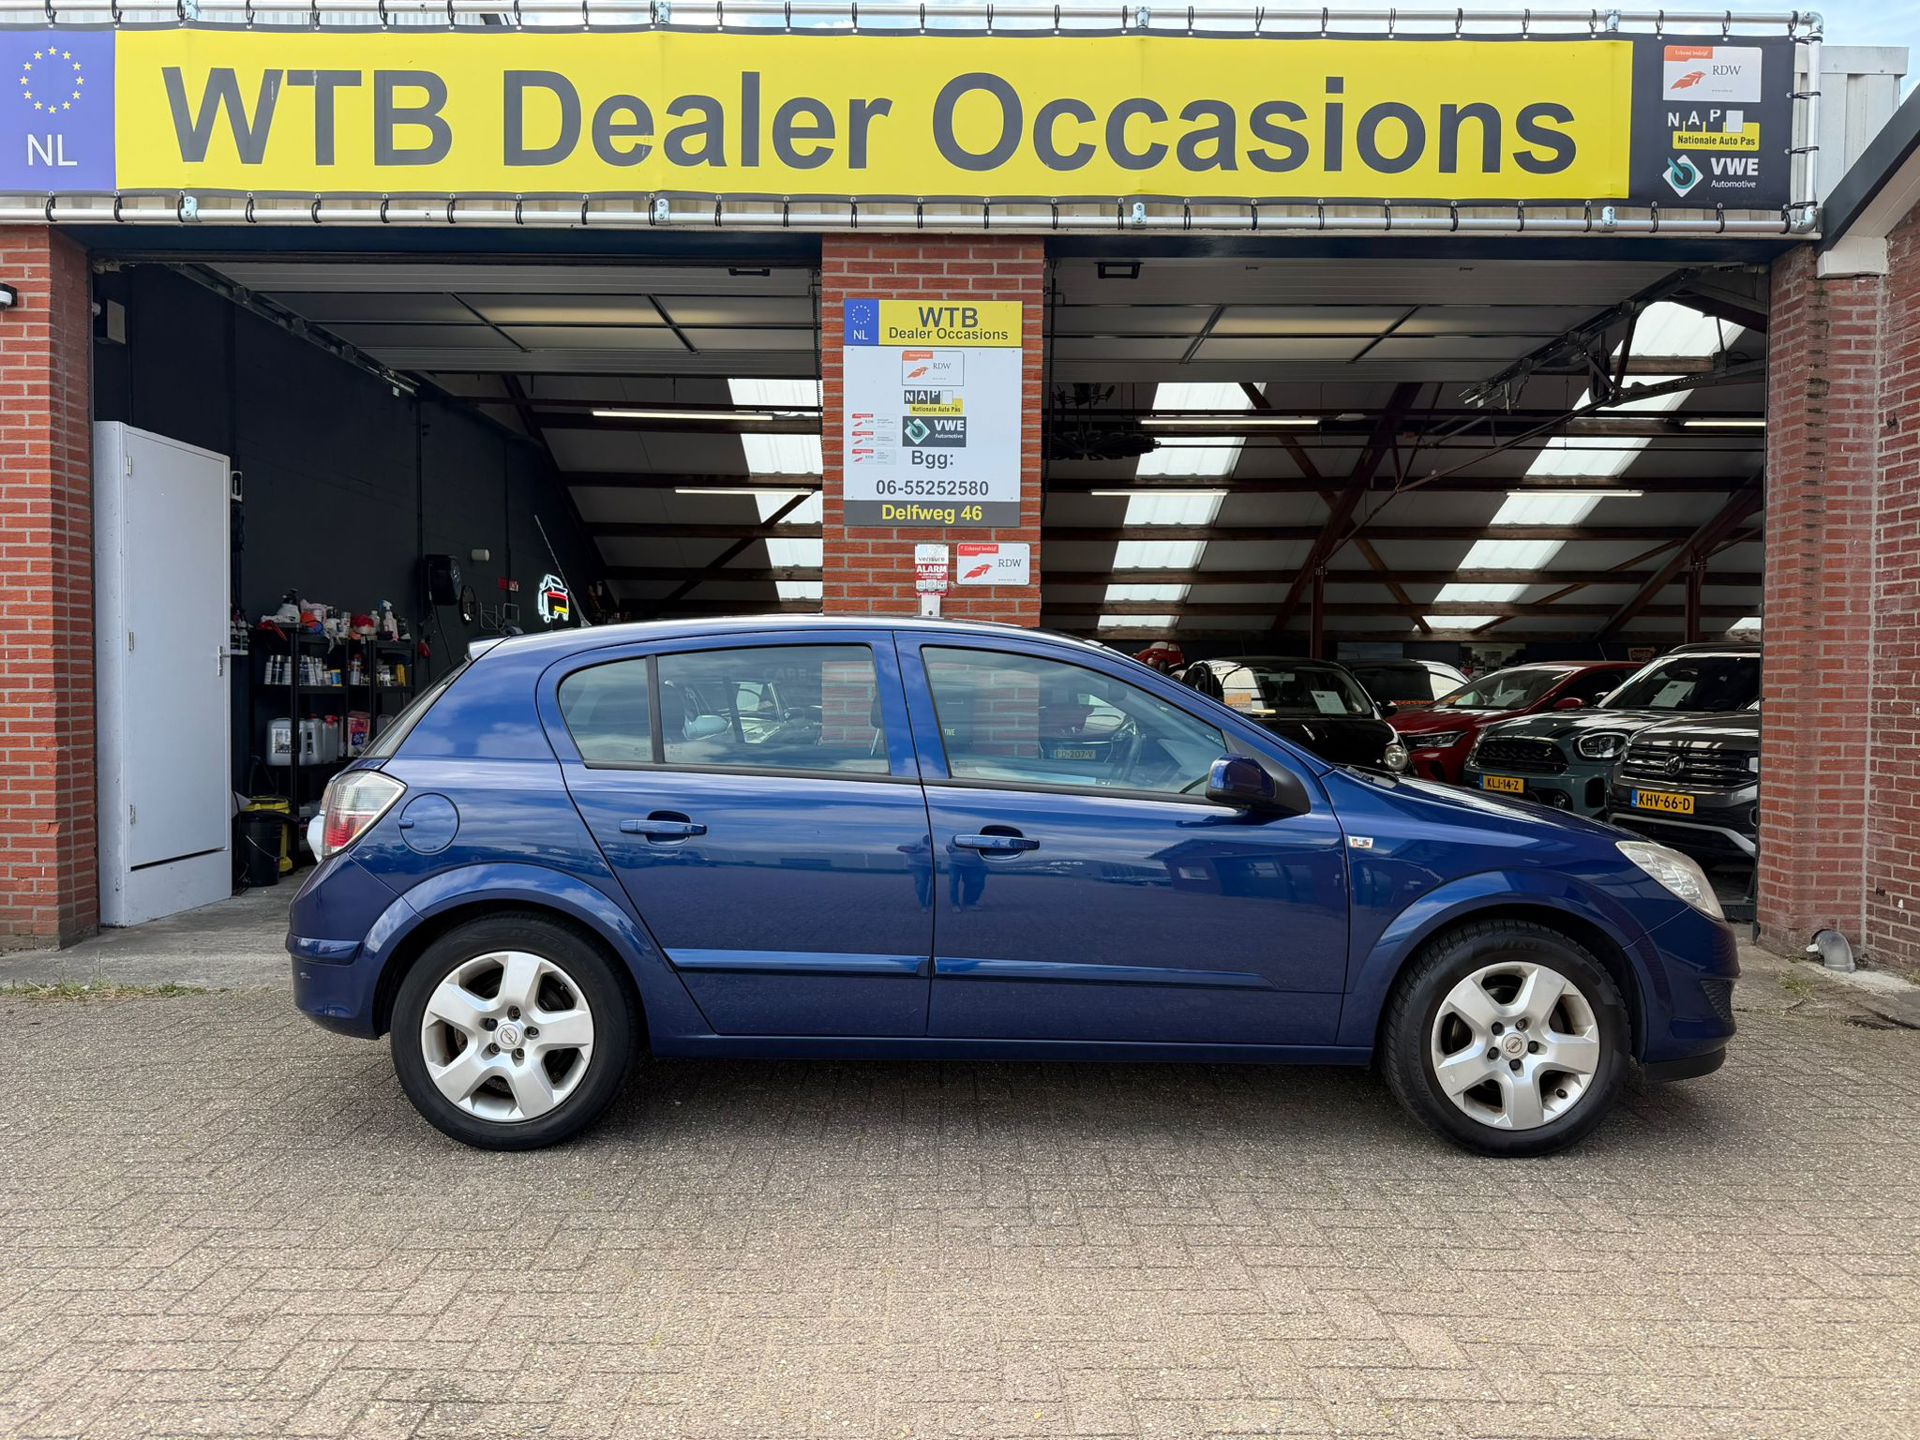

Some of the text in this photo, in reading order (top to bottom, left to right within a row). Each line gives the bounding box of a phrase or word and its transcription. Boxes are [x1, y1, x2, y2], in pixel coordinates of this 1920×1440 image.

[1712, 65, 1741, 76] RDW
[161, 66, 1577, 174] WTB Dealer Occasions
[1677, 135, 1756, 146] Nationale Auto Pas
[26, 132, 78, 167] NL
[1710, 157, 1759, 176] VWE
[1710, 179, 1756, 188] Automotive
[918, 306, 979, 328] WTB
[853, 329, 869, 341] NL
[889, 327, 1009, 341] Dealer Occasions
[934, 420, 965, 431] VWE
[911, 450, 954, 469] Bgg:
[876, 480, 989, 496] 06-55252580
[881, 504, 983, 524] Delfweg 46
[916, 565, 947, 573] ALARM
[998, 559, 1022, 567] RDW
[1487, 777, 1519, 791] KLJ-14-Z
[1639, 792, 1691, 811] KHV-66-D
